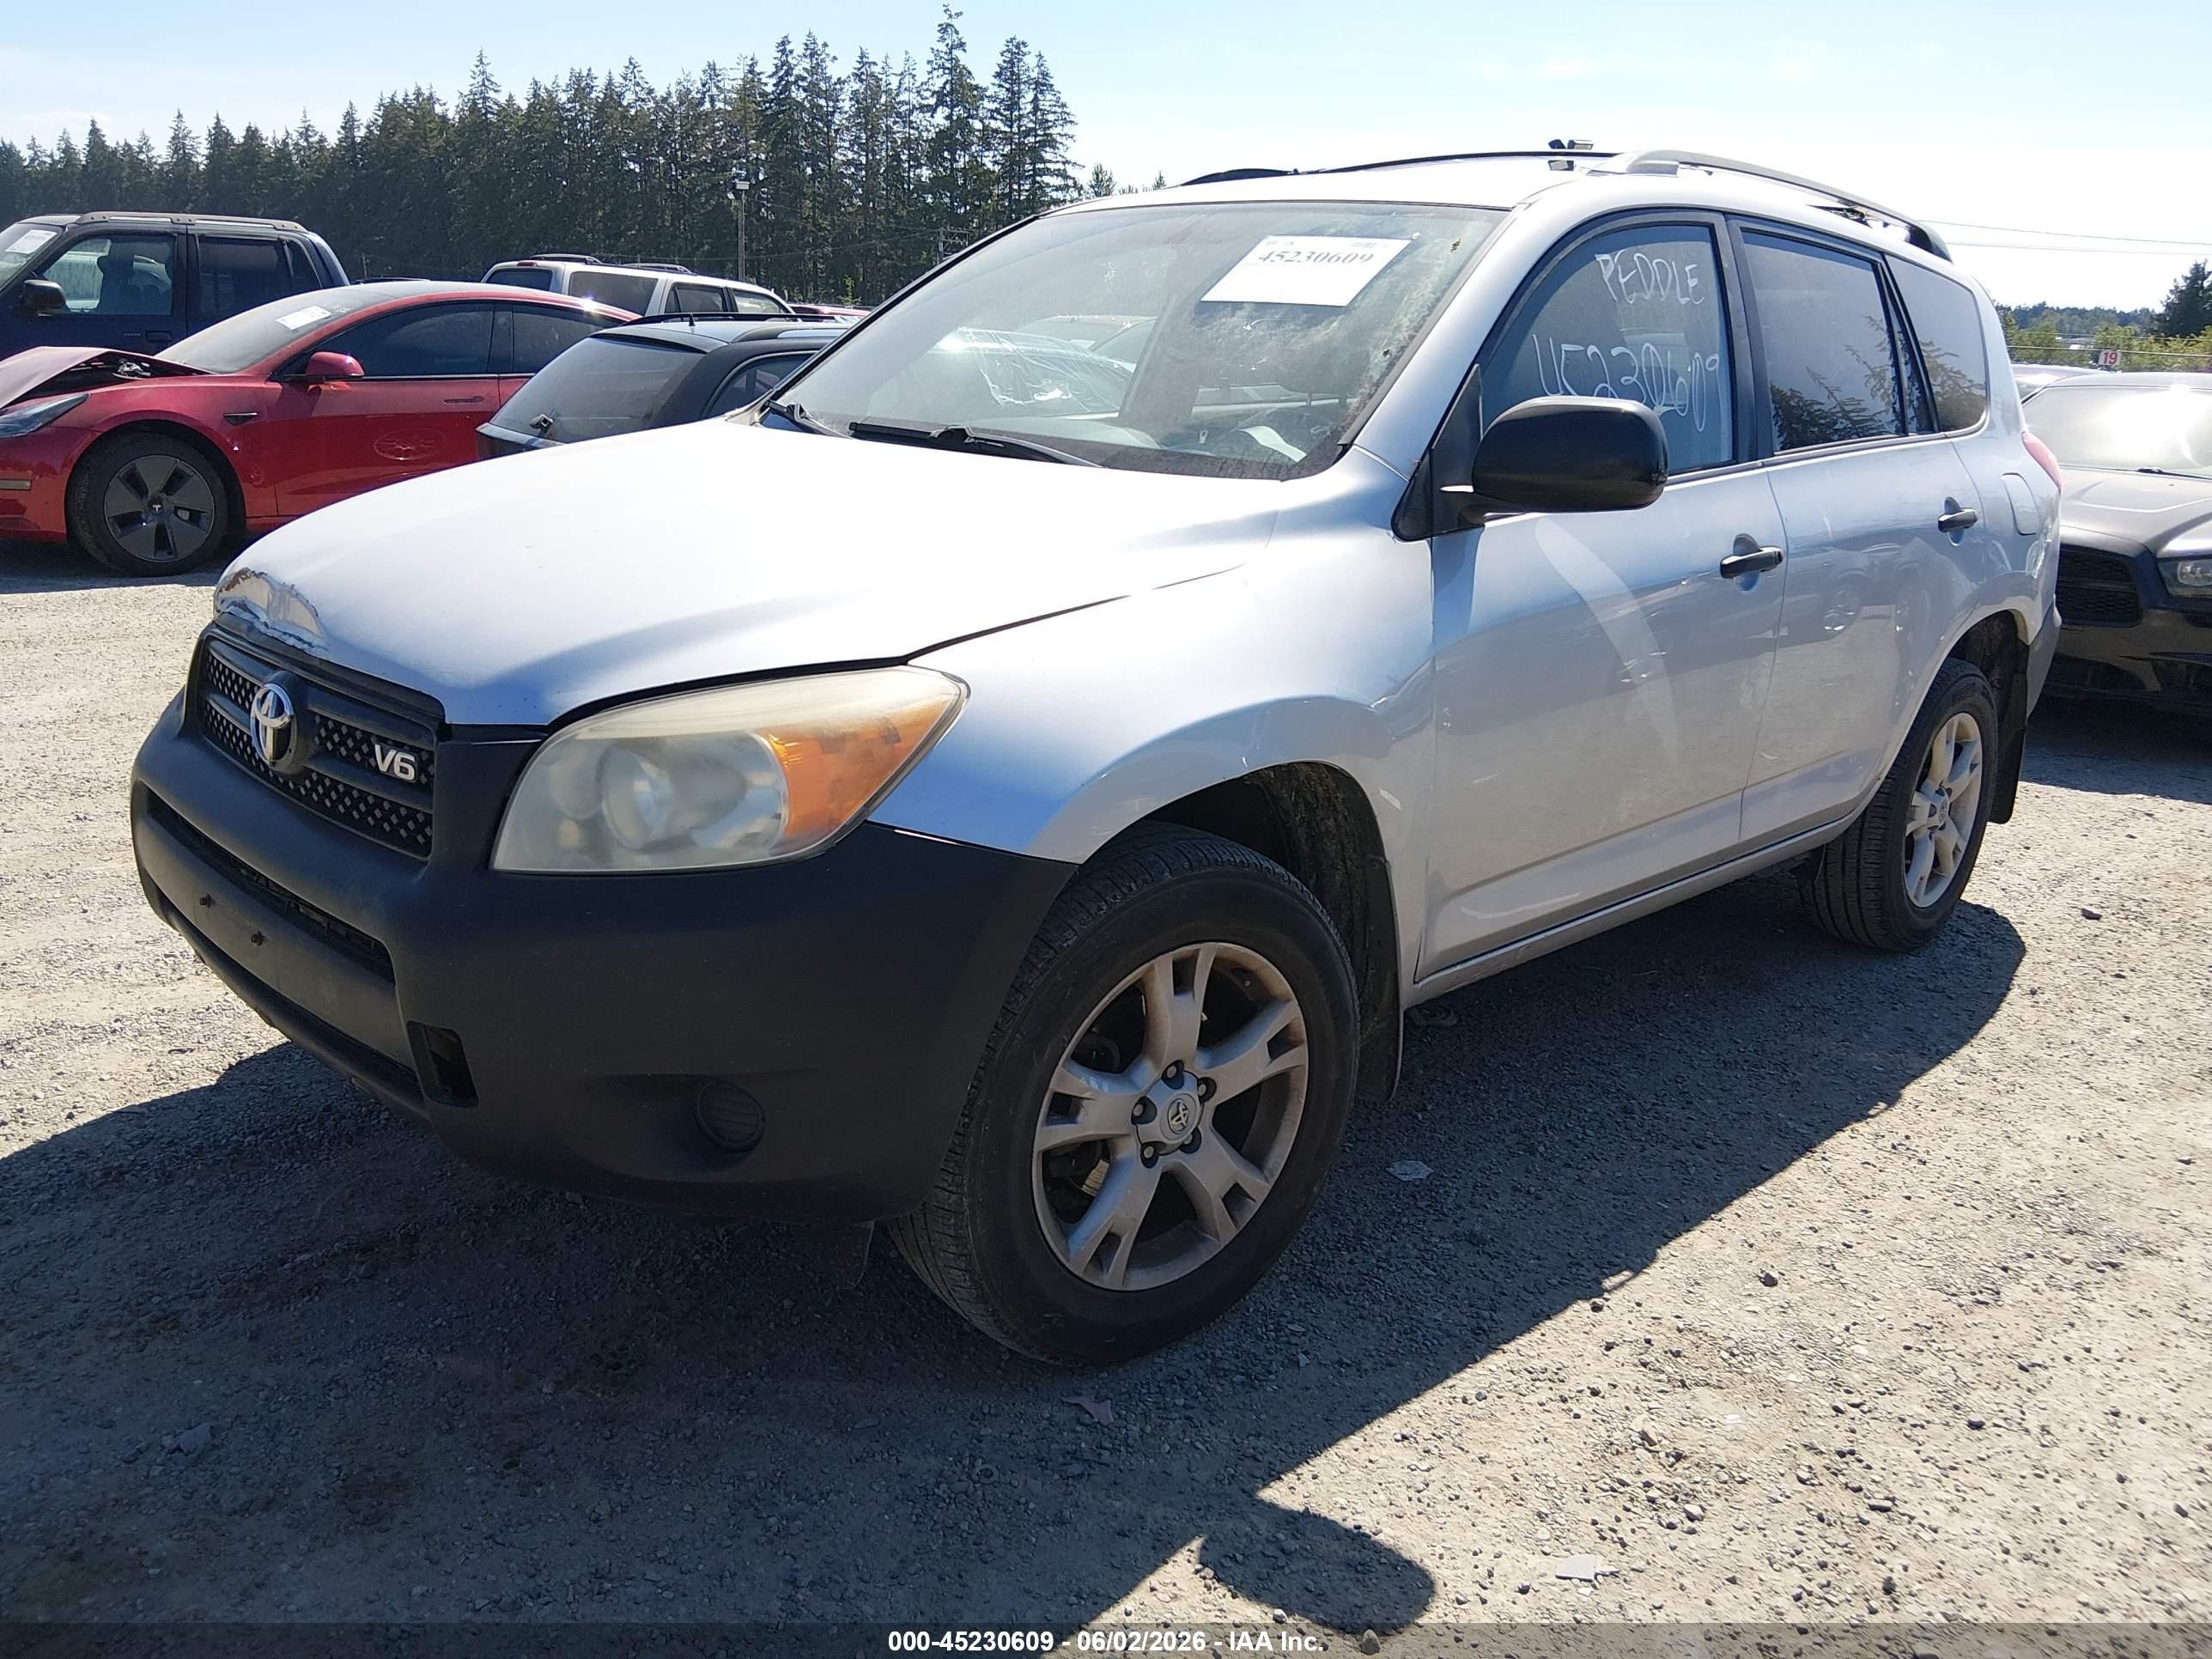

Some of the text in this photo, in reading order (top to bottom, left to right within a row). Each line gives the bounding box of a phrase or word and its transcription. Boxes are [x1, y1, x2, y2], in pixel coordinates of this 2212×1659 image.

[1258, 250, 1375, 264] 45230609
[1594, 249, 1705, 305] PEDDLE
[2103, 352, 2118, 365] 19
[374, 744, 416, 781] V6
